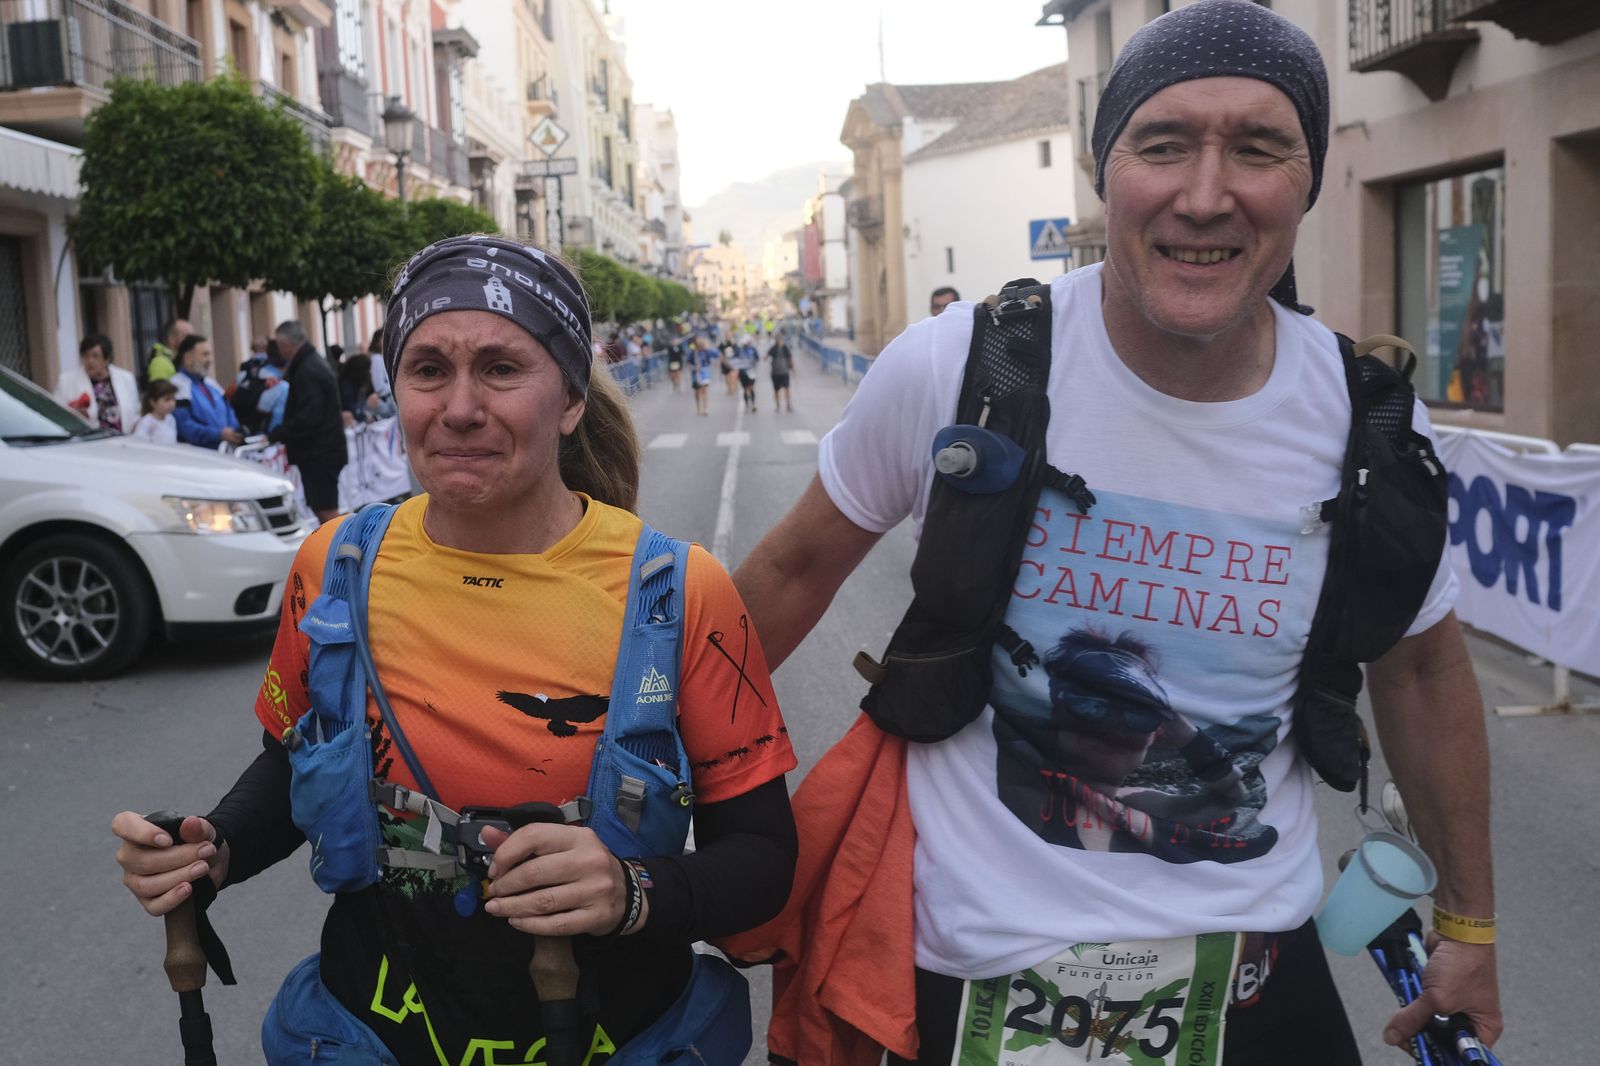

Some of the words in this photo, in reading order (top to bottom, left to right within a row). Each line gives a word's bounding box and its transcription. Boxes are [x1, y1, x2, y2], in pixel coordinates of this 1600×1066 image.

[1025, 506, 1292, 585] SIEMPRE
[462, 575, 505, 589] TACTIC
[1011, 560, 1281, 638] CAMINAS
[1057, 966, 1154, 981] Fundación
[1102, 949, 1159, 966] Unicaja
[1003, 978, 1185, 1059] 2075
